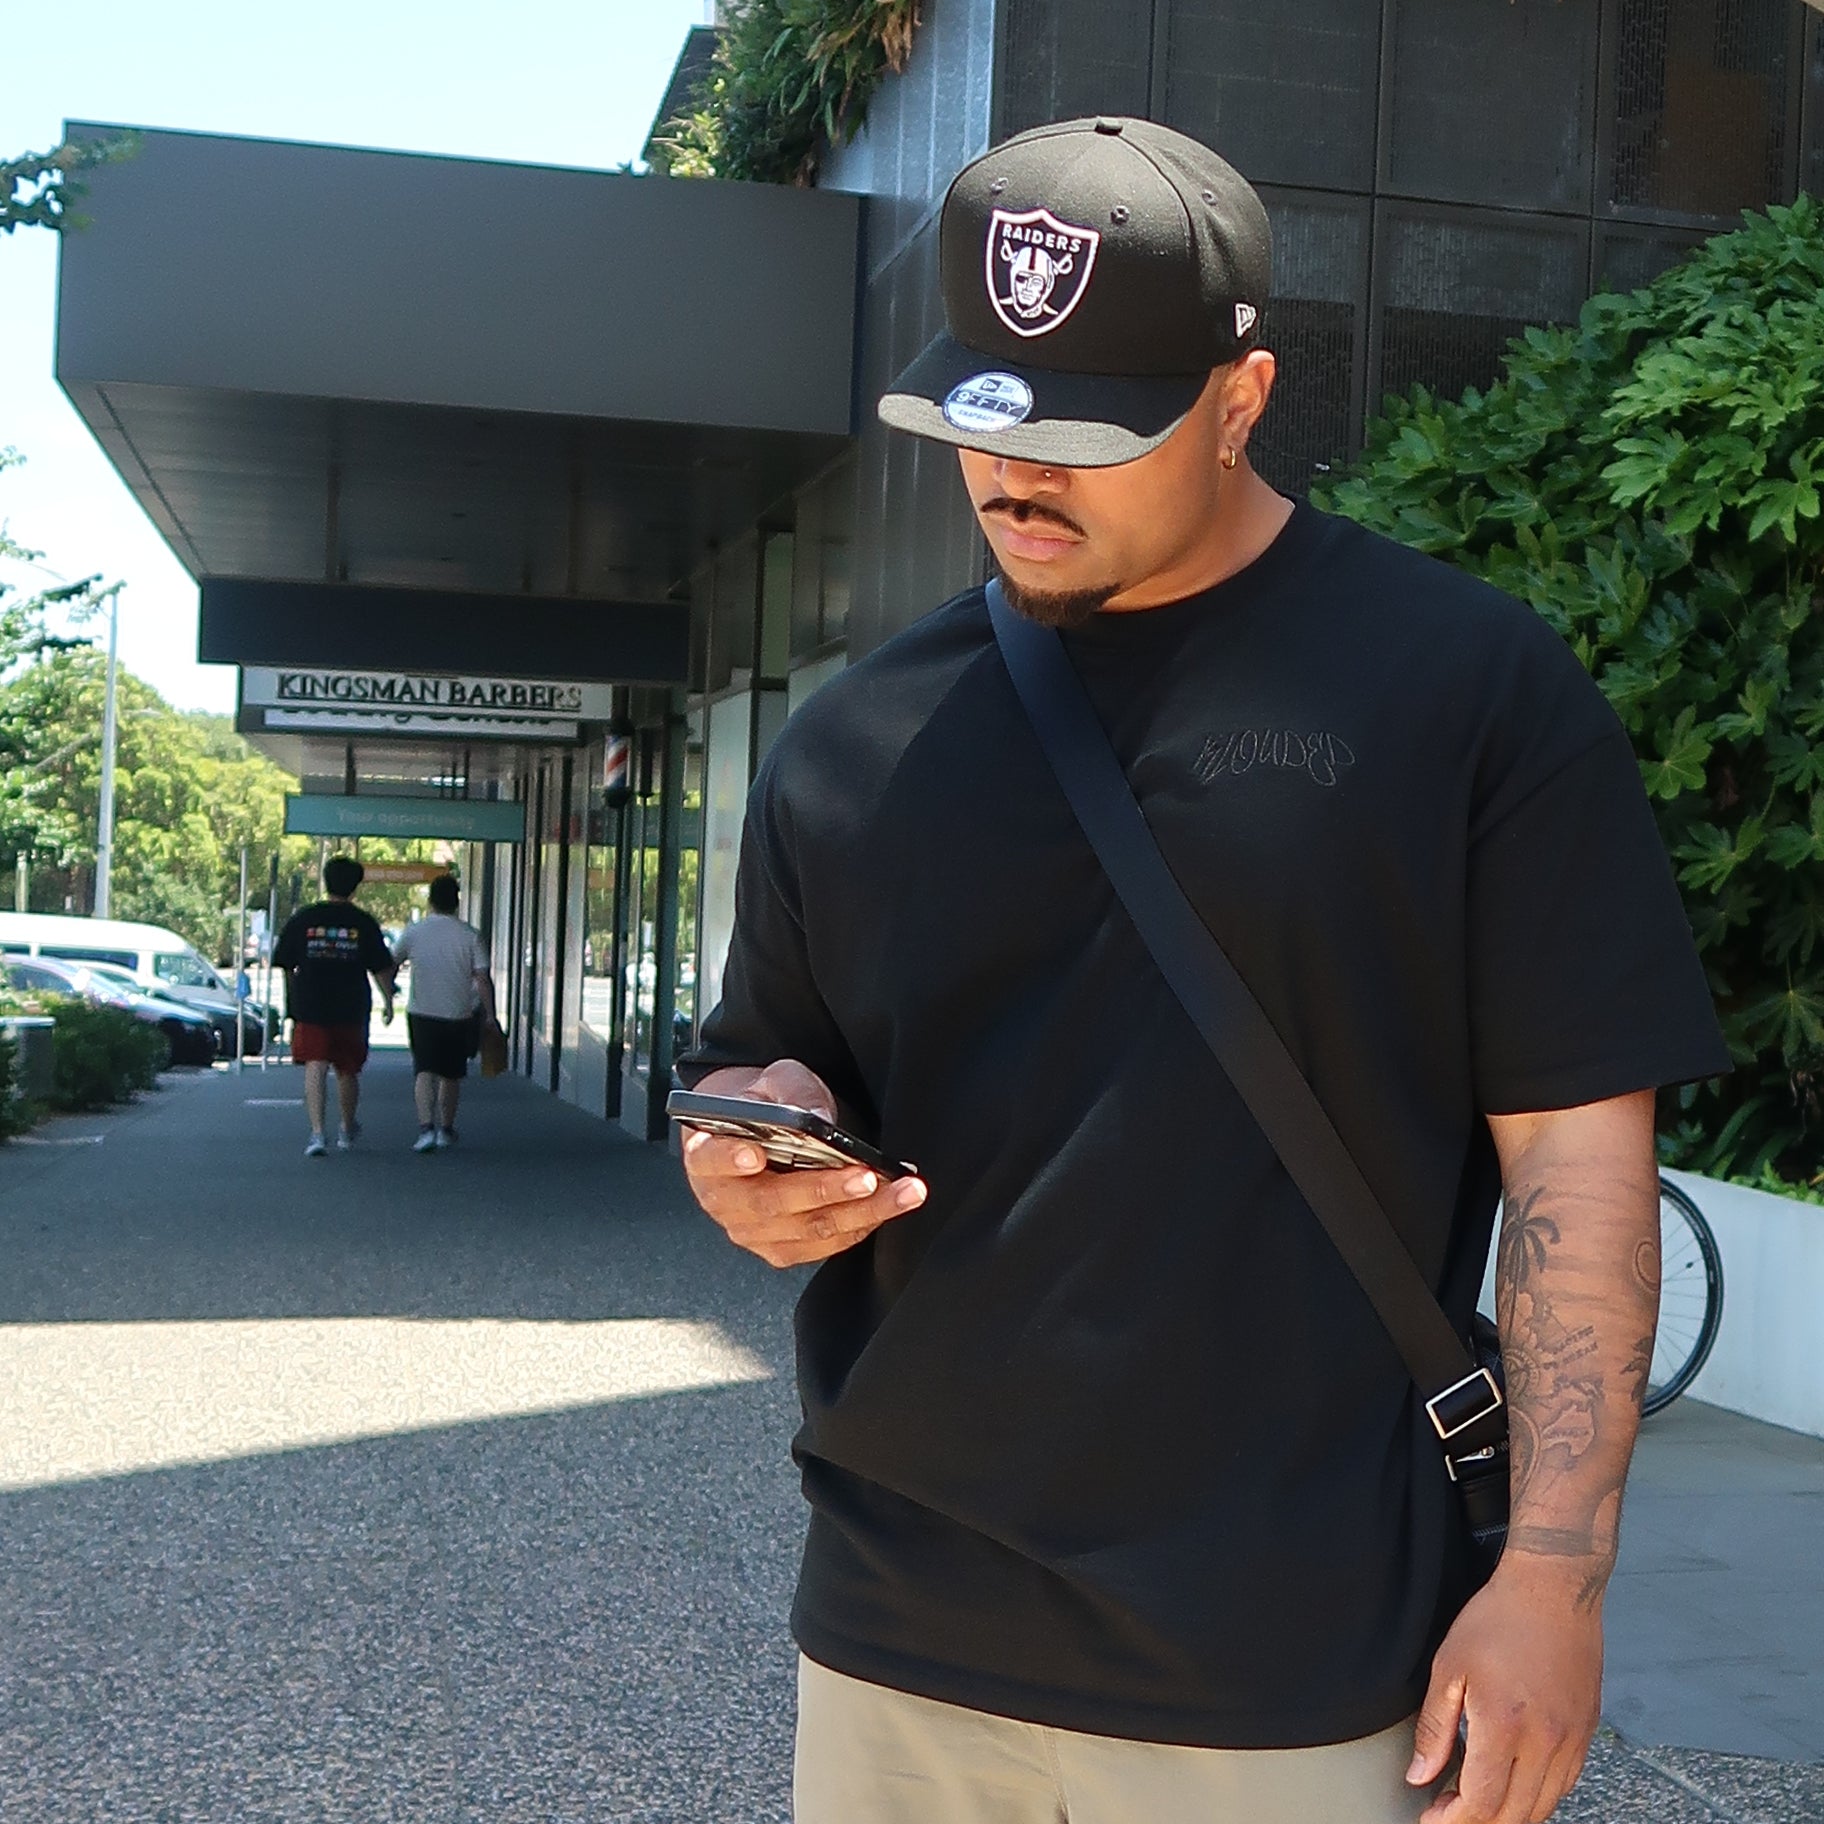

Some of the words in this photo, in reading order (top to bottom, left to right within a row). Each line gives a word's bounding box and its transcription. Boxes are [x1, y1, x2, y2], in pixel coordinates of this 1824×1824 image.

[1002, 223, 1081, 253] RAIDERS
[277, 673, 439, 704] KINGSMAN
[450, 683, 582, 710] BARBERS
